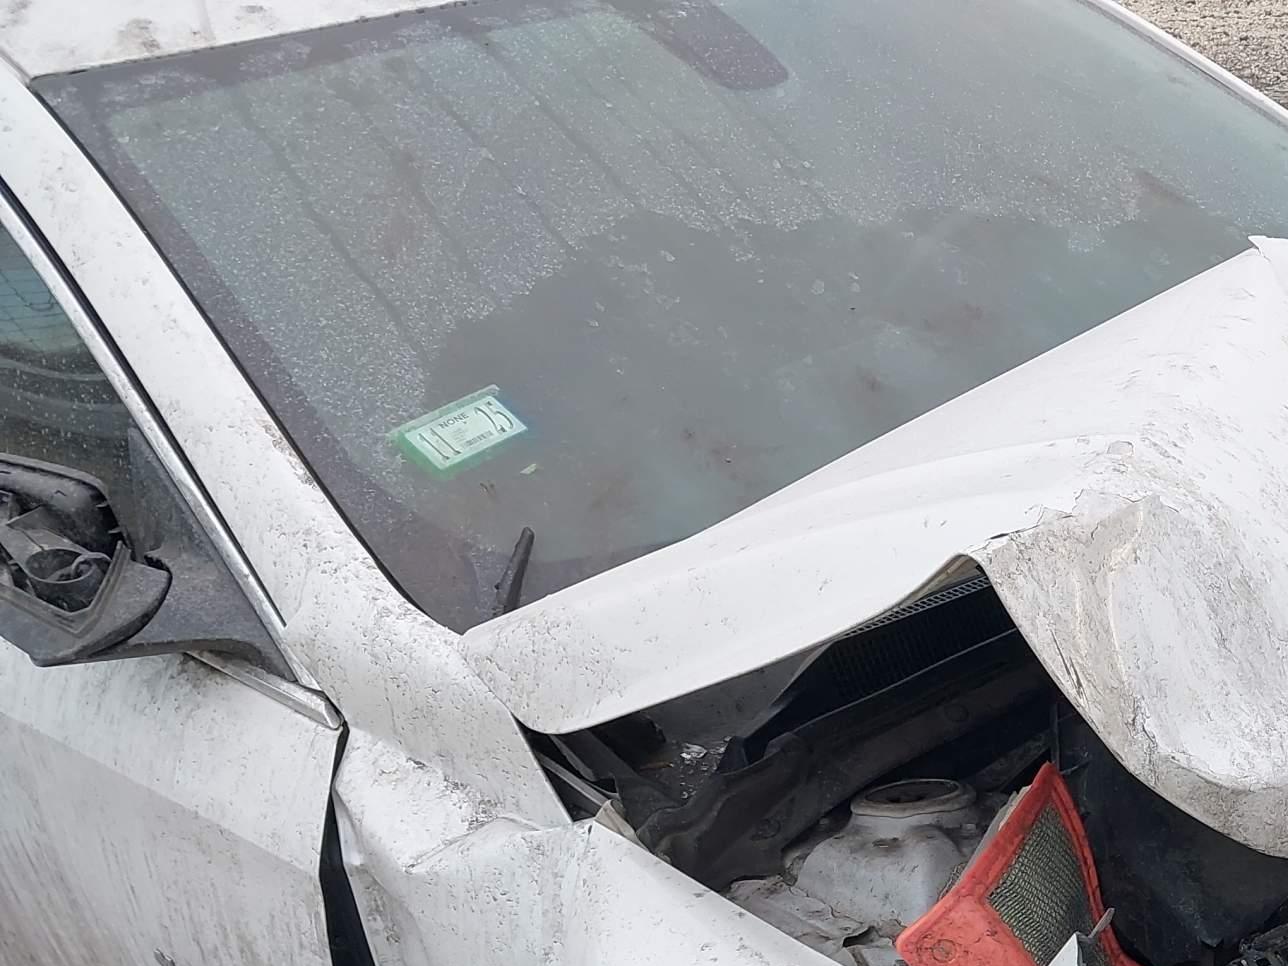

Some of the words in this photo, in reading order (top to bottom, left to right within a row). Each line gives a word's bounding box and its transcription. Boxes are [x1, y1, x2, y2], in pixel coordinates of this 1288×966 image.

[417, 427, 462, 460] 11
[474, 400, 515, 434] 25
[438, 411, 470, 430] NONE
